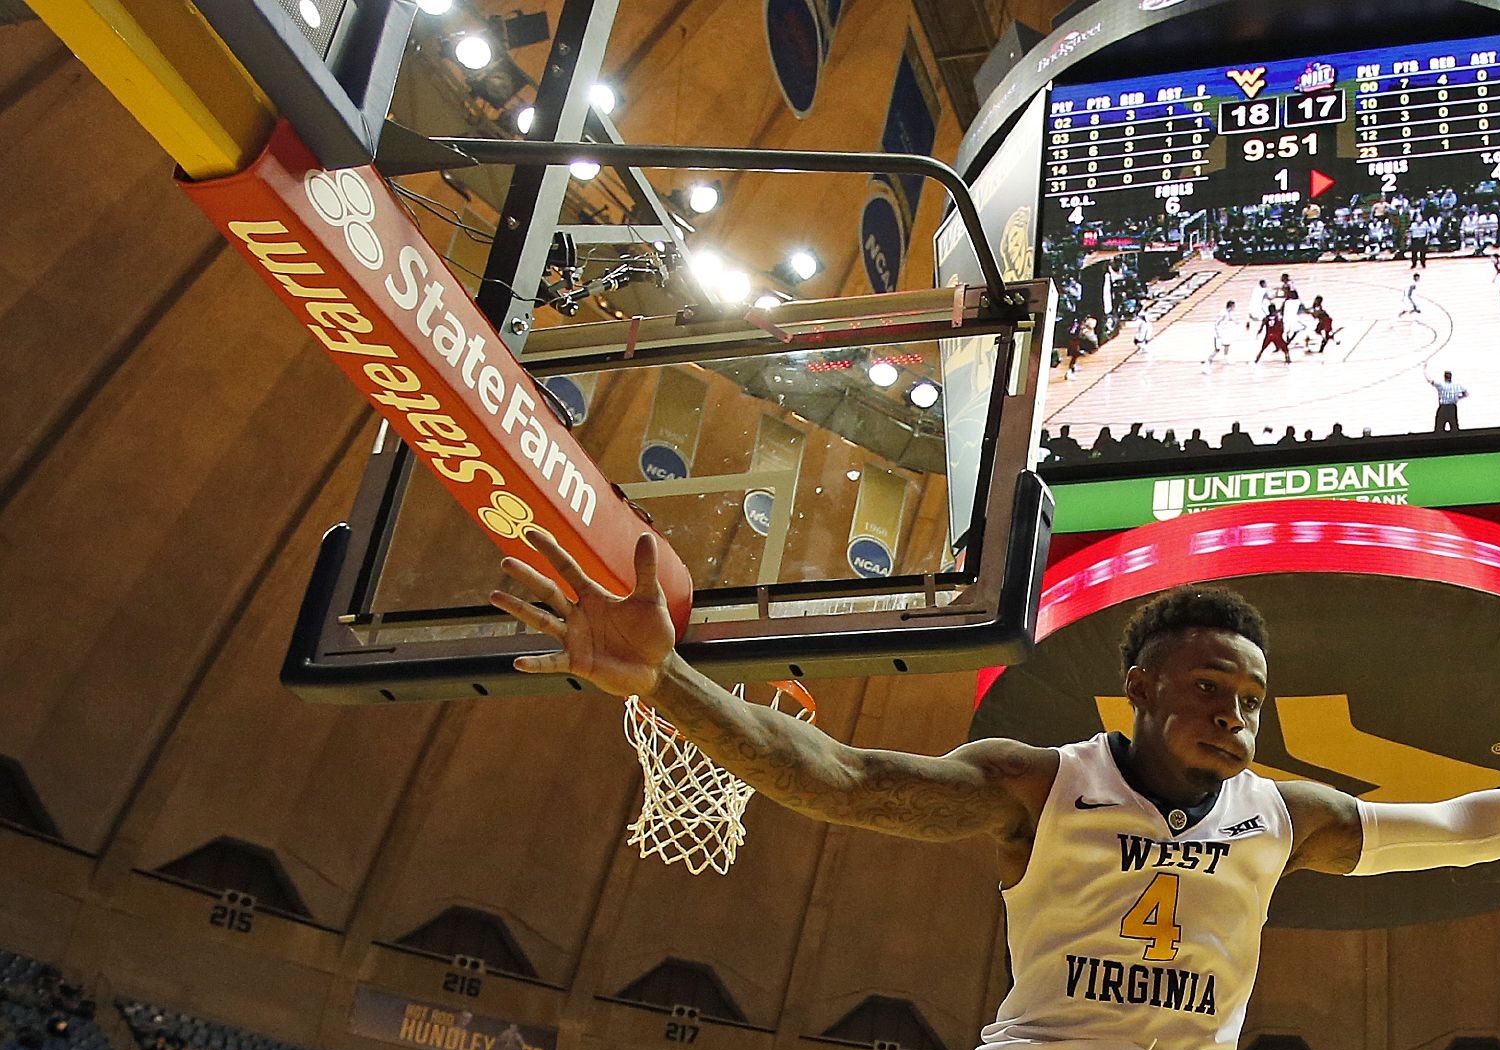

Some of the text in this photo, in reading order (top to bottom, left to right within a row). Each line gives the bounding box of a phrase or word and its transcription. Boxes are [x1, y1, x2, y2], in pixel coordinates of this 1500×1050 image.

[1477, 70, 1487, 81] 0
[1400, 94, 1409, 105] 0
[1438, 90, 1448, 101] 0
[1478, 85, 1487, 97] 0
[1167, 106, 1173, 115] 1
[1193, 102, 1203, 112] 0
[1231, 104, 1269, 126] 18
[1298, 95, 1337, 119] 17
[1438, 106, 1449, 117] 0
[1478, 102, 1488, 113] 0
[1090, 130, 1099, 141] 0
[1125, 126, 1135, 136] 0
[1166, 121, 1173, 131] 1
[1194, 117, 1203, 128] 1
[1402, 127, 1411, 138] 0
[1439, 123, 1449, 134] 0
[1479, 119, 1489, 130] 0
[1165, 137, 1172, 147] 1
[1192, 133, 1202, 144] 0
[1243, 132, 1318, 161] 9:51
[1441, 139, 1449, 150] 1
[1481, 135, 1490, 146] 1
[1088, 162, 1098, 172] 0
[1124, 157, 1133, 168] 0
[1162, 153, 1172, 164] 0
[1192, 150, 1202, 160] 0
[1087, 178, 1097, 188] 0
[1123, 173, 1133, 184] 0
[1162, 169, 1171, 180] 0
[1193, 165, 1201, 176] 1
[1274, 168, 1288, 190] 1
[1381, 173, 1397, 192] 2
[1068, 206, 1085, 226] 4
[1165, 197, 1181, 214] 6
[1187, 462, 1409, 501] UNITED BANK
[853, 555, 889, 578] NCAA
[1117, 833, 1230, 875] WEST
[210, 905, 253, 933] 215
[1119, 871, 1182, 962] 4
[1065, 954, 1216, 1016] VIRGINIA
[664, 1022, 700, 1045] 217
